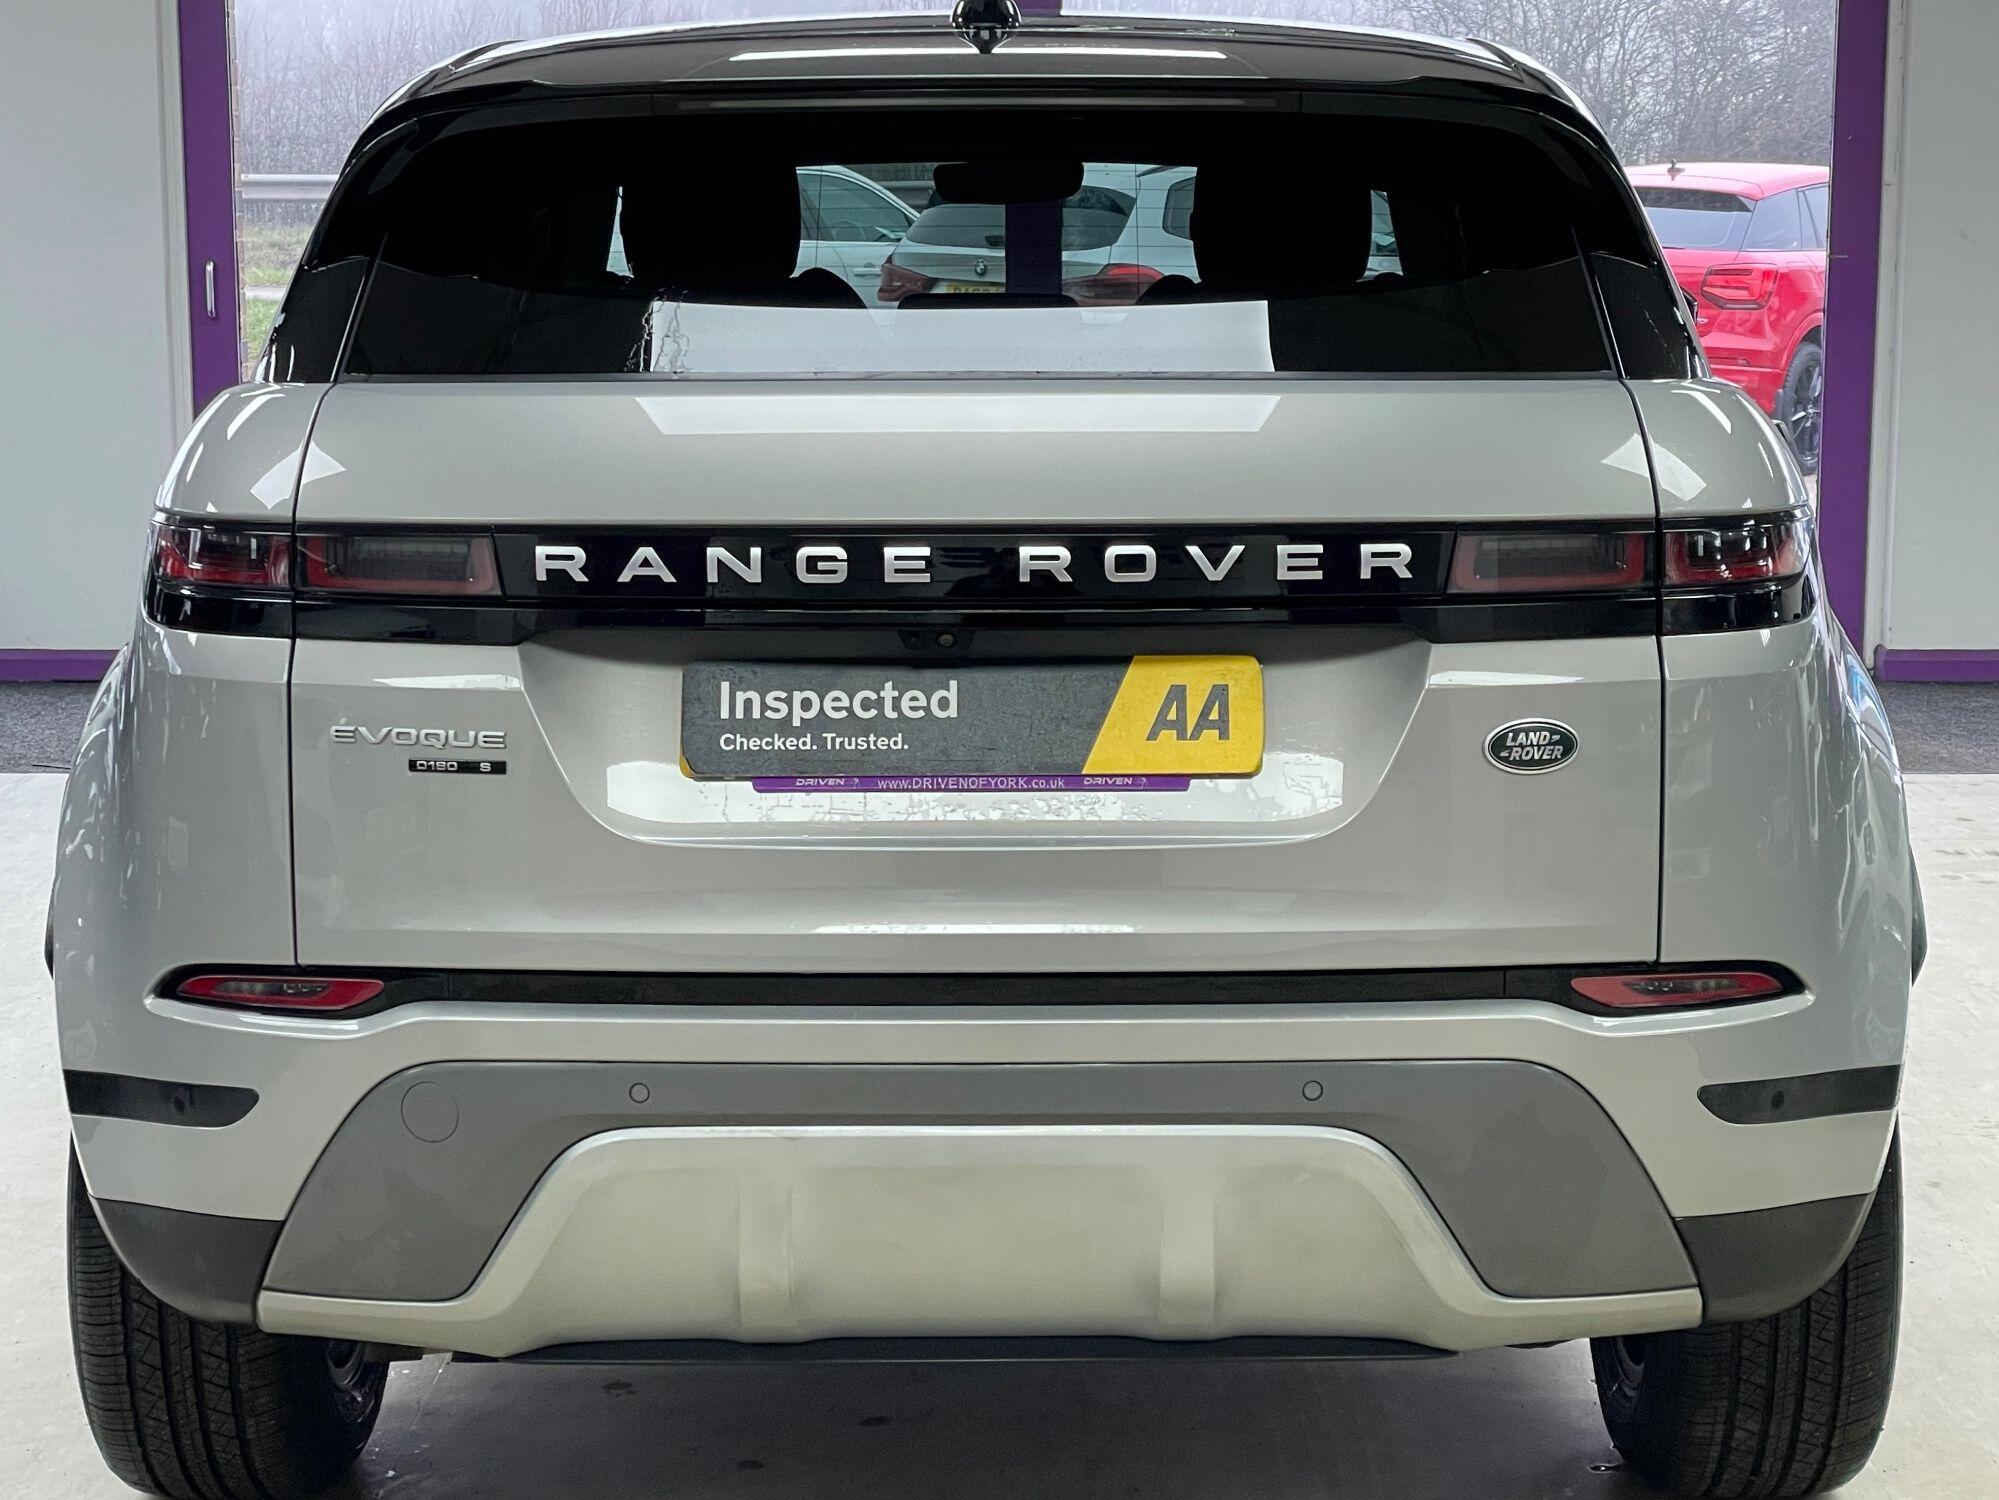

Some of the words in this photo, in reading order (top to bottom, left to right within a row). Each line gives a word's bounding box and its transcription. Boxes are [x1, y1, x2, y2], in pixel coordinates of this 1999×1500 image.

[534, 545, 934, 584] RANGE
[1017, 542, 1414, 583] ROVER
[718, 680, 959, 726] Inspected
[1145, 683, 1232, 742] AA
[329, 717, 508, 749] ÉVOQUE
[719, 732, 818, 752] Checked.
[822, 732, 910, 752] Trusted.
[1505, 731, 1551, 746] LAND
[1508, 745, 1564, 761] ROVER
[415, 760, 458, 771] D180
[479, 762, 492, 772] S
[795, 777, 846, 786] DRIVEN
[877, 776, 1065, 790] www.DRIVENOFYORK.co.uk
[1083, 777, 1133, 786] DRIVEN
